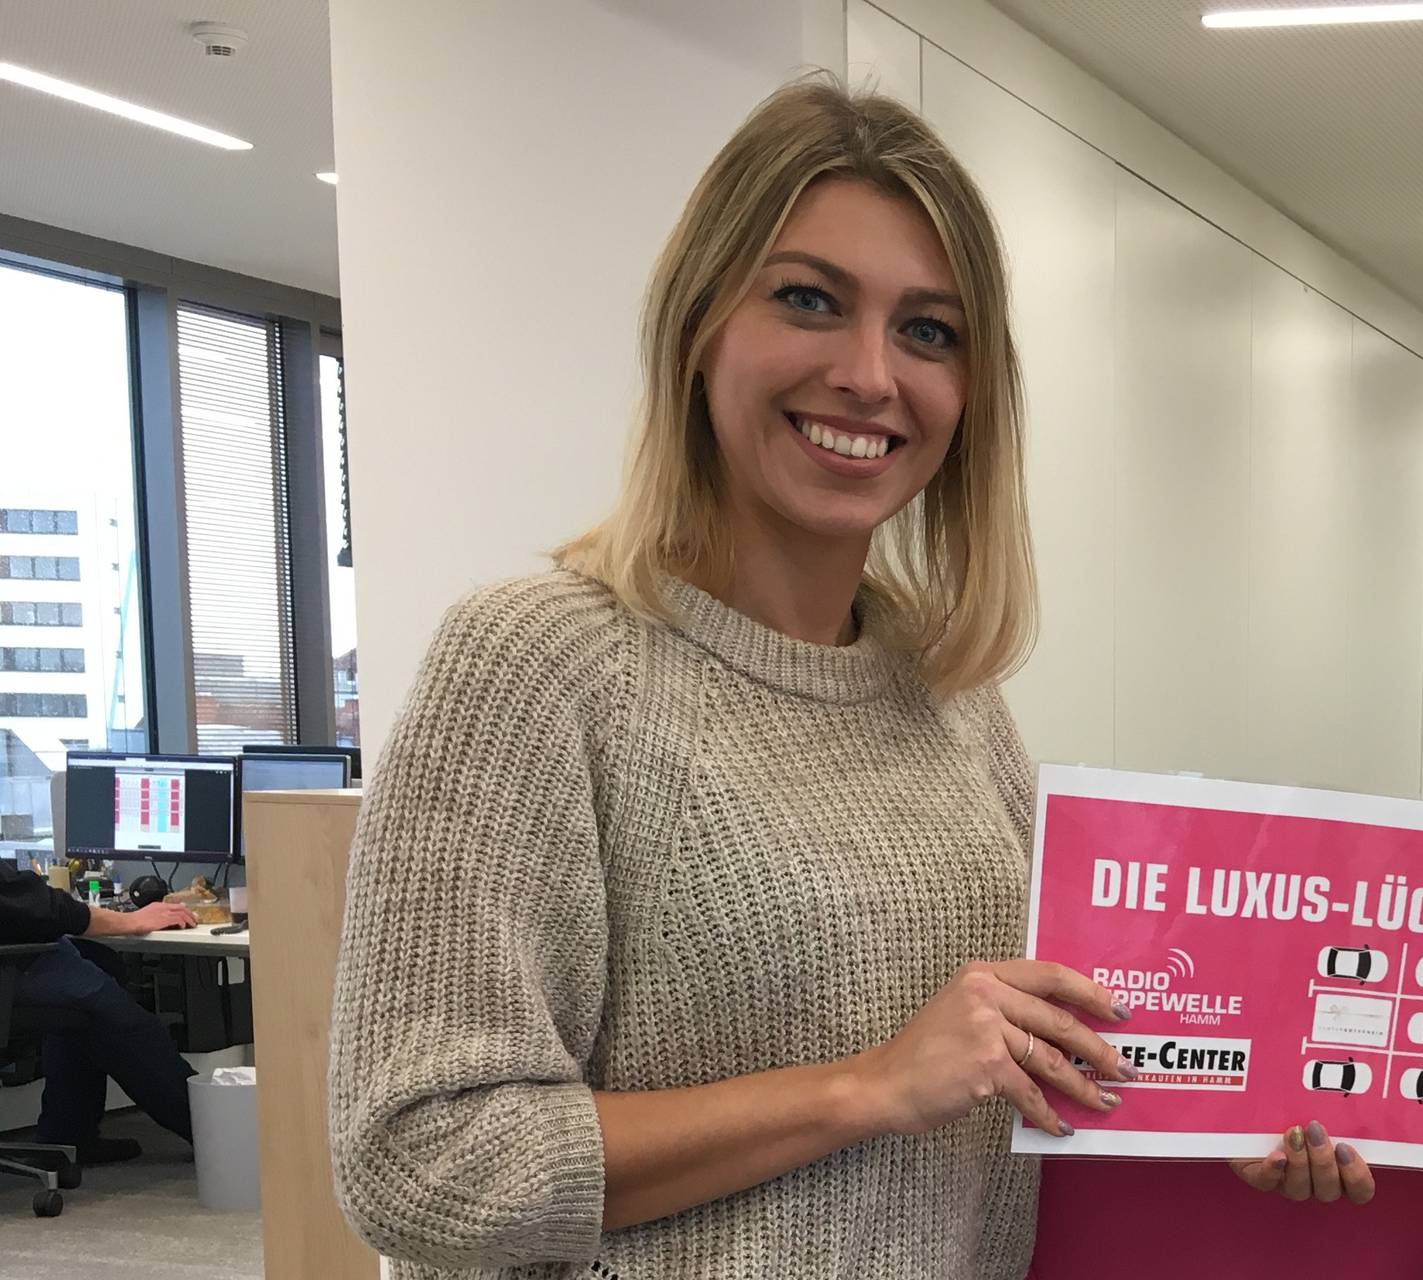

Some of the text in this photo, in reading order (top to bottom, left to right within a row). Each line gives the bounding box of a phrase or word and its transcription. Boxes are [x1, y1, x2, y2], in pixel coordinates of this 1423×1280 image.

[1092, 859, 1168, 912] DIE
[1092, 968, 1170, 991] RADIO
[1106, 989, 1243, 1015] PPEWELLE
[1180, 1014, 1221, 1026] HAMM
[1074, 1041, 1246, 1071] EE-CENTER
[1132, 1073, 1182, 1083] NKAUFEN
